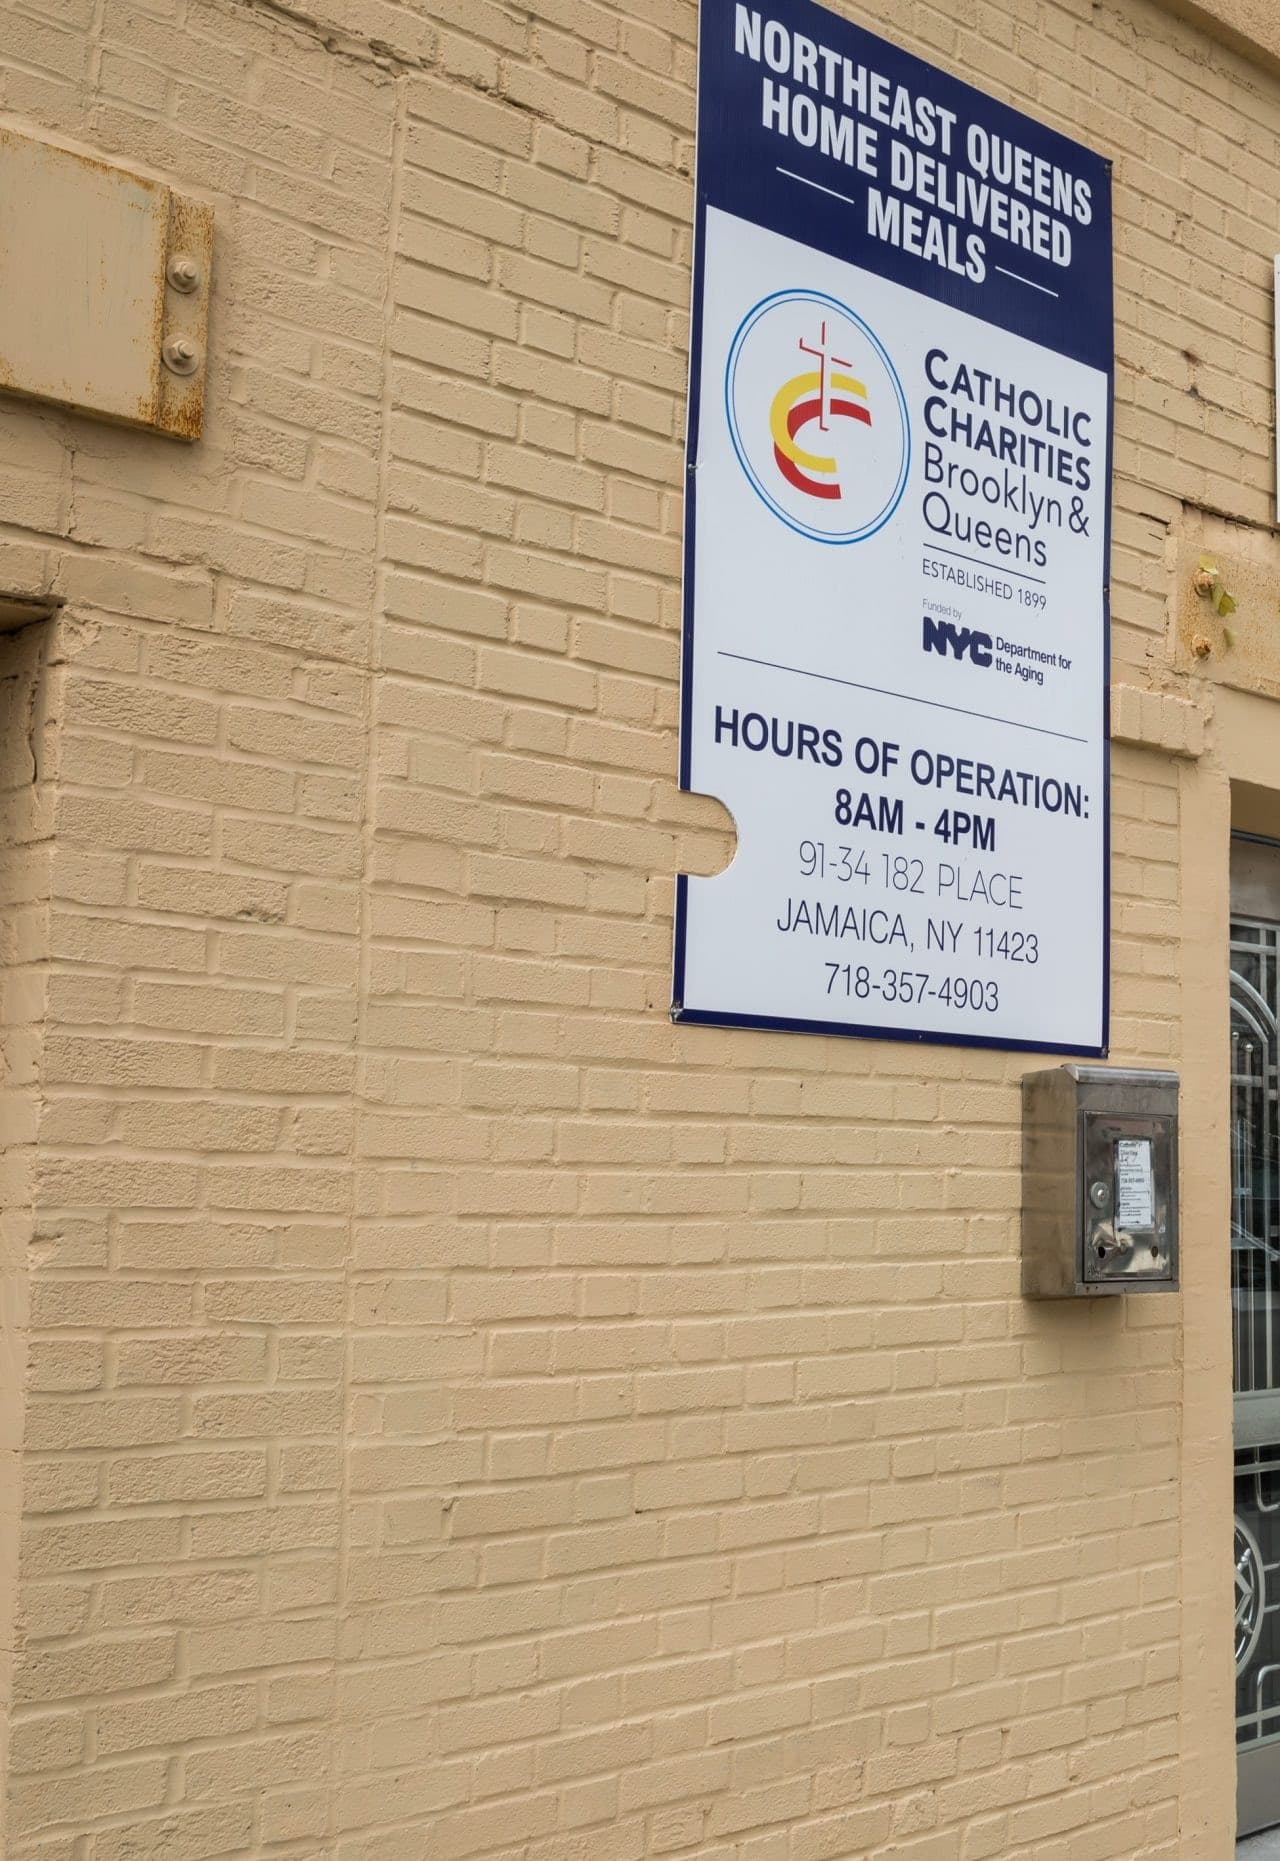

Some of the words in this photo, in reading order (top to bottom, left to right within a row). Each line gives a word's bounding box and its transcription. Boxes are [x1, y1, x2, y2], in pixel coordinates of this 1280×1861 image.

[734, 3, 956, 156] NORTHEAST
[967, 124, 1092, 225] QUEENS
[762, 77, 878, 177] HOME
[891, 140, 1072, 267] DELIVERED
[867, 187, 985, 283] MEALS
[924, 348, 1091, 447] CATHOLIC
[923, 395, 1090, 491] CHARITIES
[923, 492, 1047, 567] Queens
[922, 599, 951, 616] Funded
[953, 609, 962, 620] by
[923, 558, 1013, 600] ESTABLISHED
[1018, 588, 1047, 610] 1899
[923, 616, 992, 667] NYC
[996, 637, 1056, 667] Department
[1059, 655, 1072, 670] for
[996, 658, 1012, 673] the
[1015, 663, 1044, 685] Aging
[715, 705, 843, 767] HOURS
[855, 736, 900, 777] OF
[910, 749, 1089, 819] OPERATION:
[835, 788, 904, 835] 8AM
[934, 809, 996, 852] 4PM
[799, 840, 871, 885] 91-34
[882, 853, 925, 894] 182
[938, 864, 1024, 909] PLACE
[777, 898, 915, 952] JAMAICA,
[926, 918, 963, 954] NY
[973, 928, 1039, 964] 11423
[825, 962, 999, 1012] 718-357-4903
